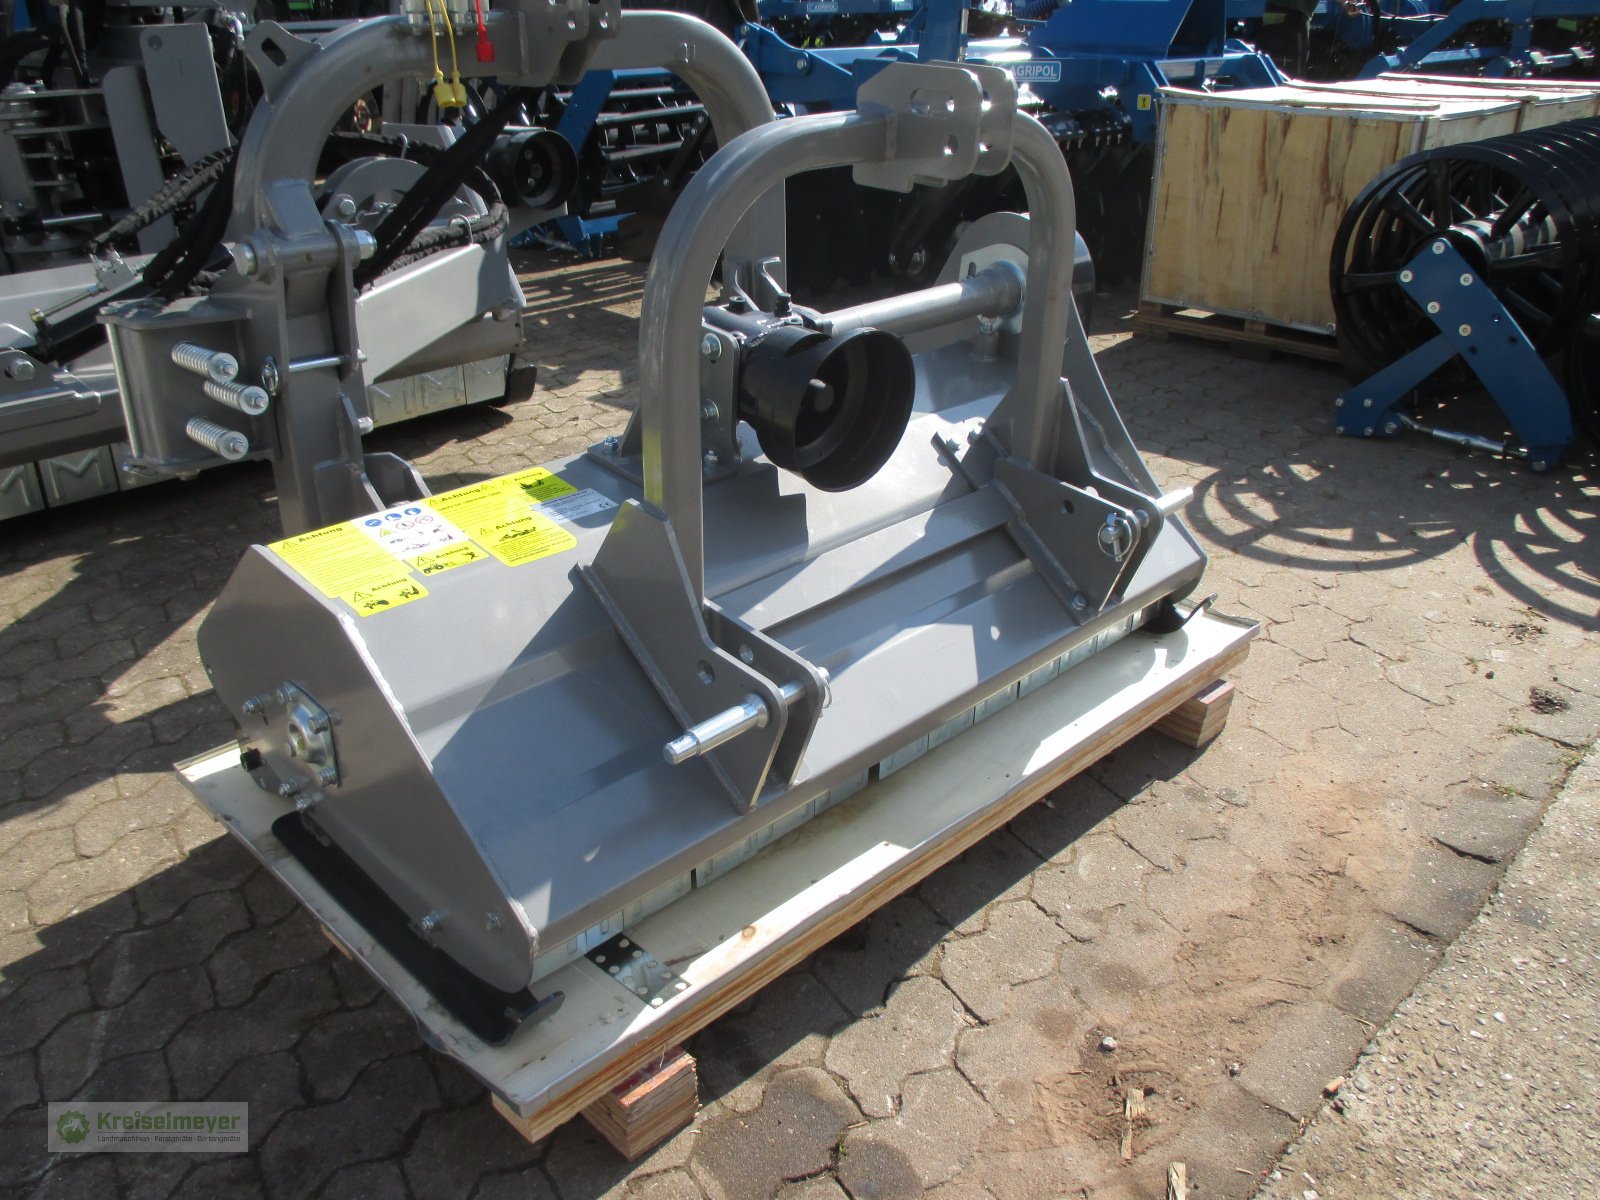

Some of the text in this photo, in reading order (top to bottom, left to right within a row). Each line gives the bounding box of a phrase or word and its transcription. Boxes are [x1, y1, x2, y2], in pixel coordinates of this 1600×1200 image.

[1010, 65, 1057, 77] AGRIPOL
[514, 471, 543, 482] Achtung
[441, 488, 482, 502] Achtung
[495, 516, 533, 530] Achtung
[298, 526, 343, 542] Achtung
[436, 546, 469, 559] Achtung
[371, 577, 408, 592] Achtung
